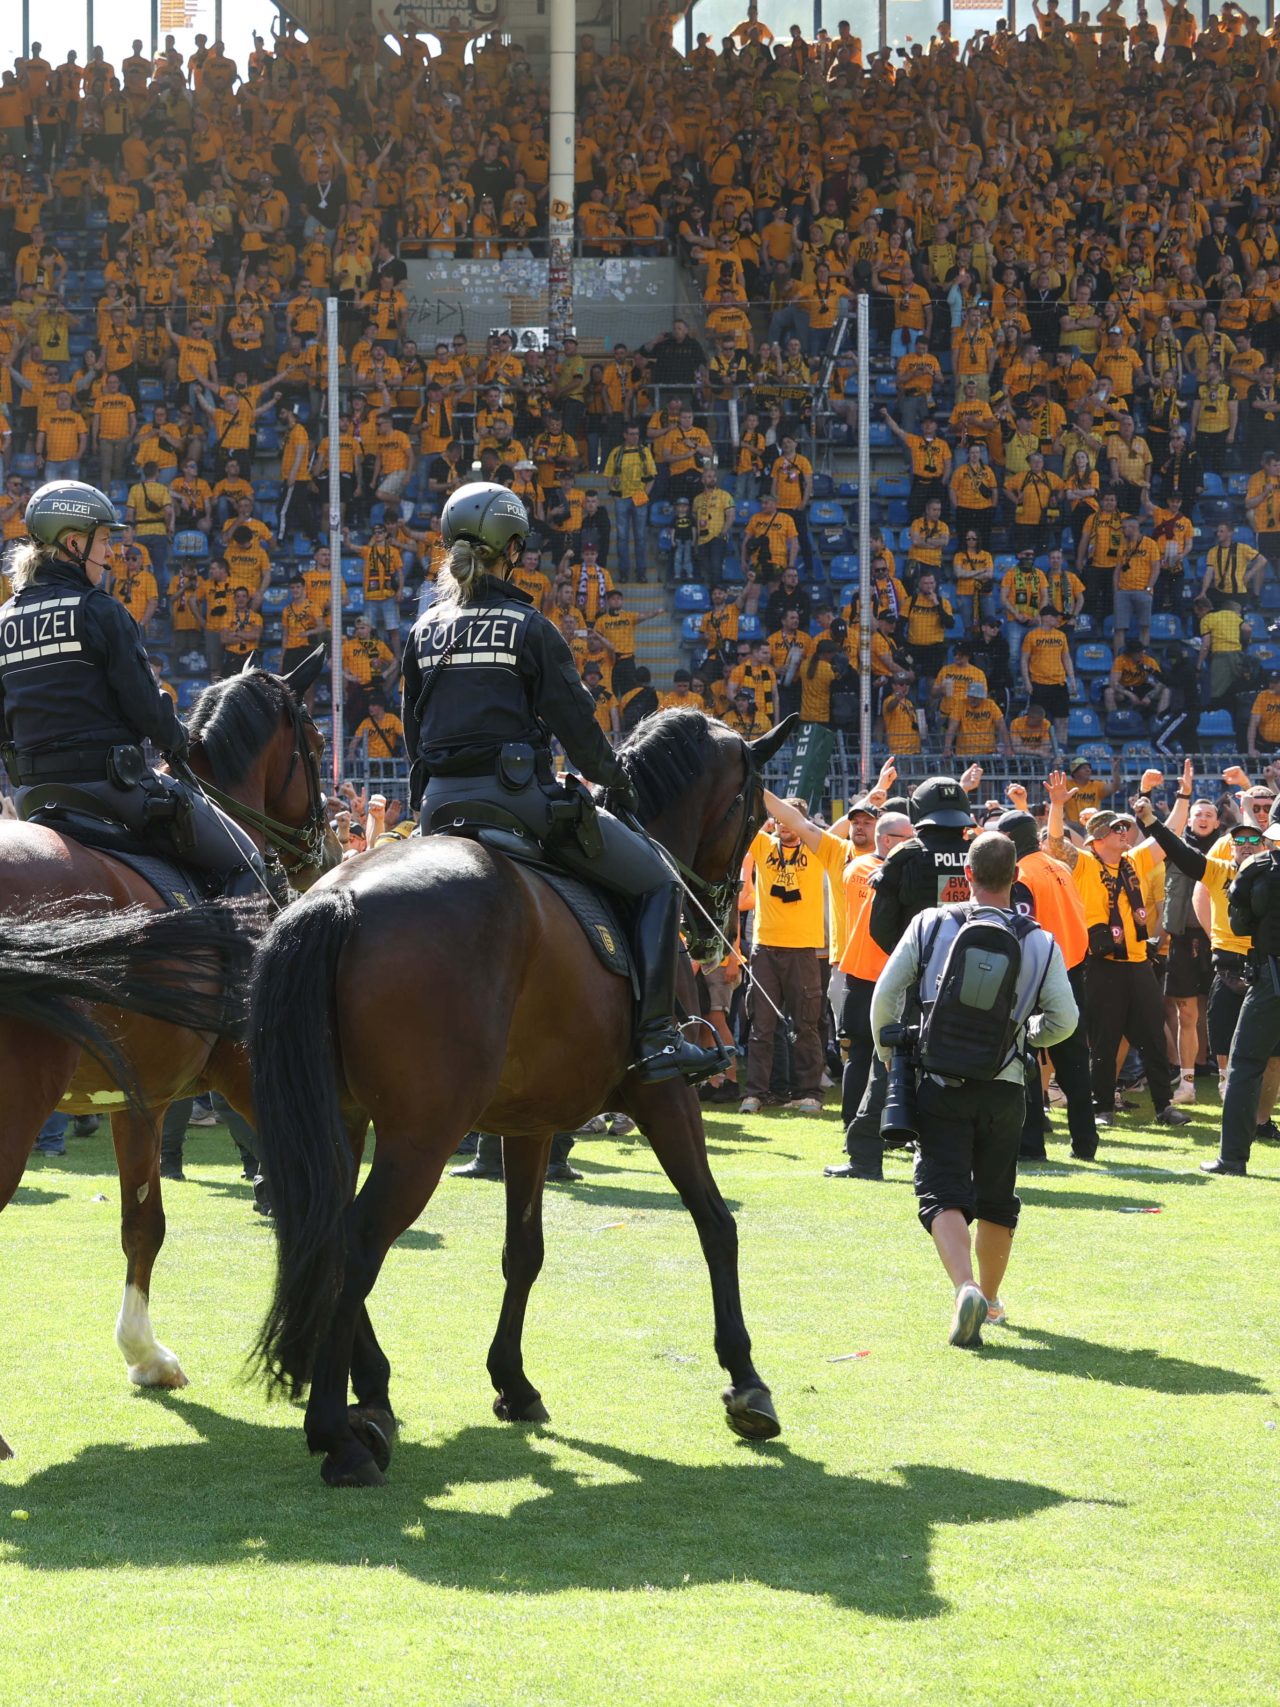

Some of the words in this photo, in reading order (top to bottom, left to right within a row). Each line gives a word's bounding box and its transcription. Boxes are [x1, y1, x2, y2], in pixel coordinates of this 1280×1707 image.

[102, 400, 126, 408] DYNAMO
[52, 501, 91, 515] POLIZEI
[231, 556, 258, 564] DYNAMO
[962, 558, 987, 566] DYNAMO
[605, 620, 630, 628] DYNAMO
[416, 620, 518, 652] POLIZEI
[1036, 638, 1062, 648] DYNAMO
[945, 674, 973, 683] DYNAMO
[965, 710, 992, 720] DYNAMO
[942, 787, 956, 796] IV
[935, 852, 970, 867] POLIZ
